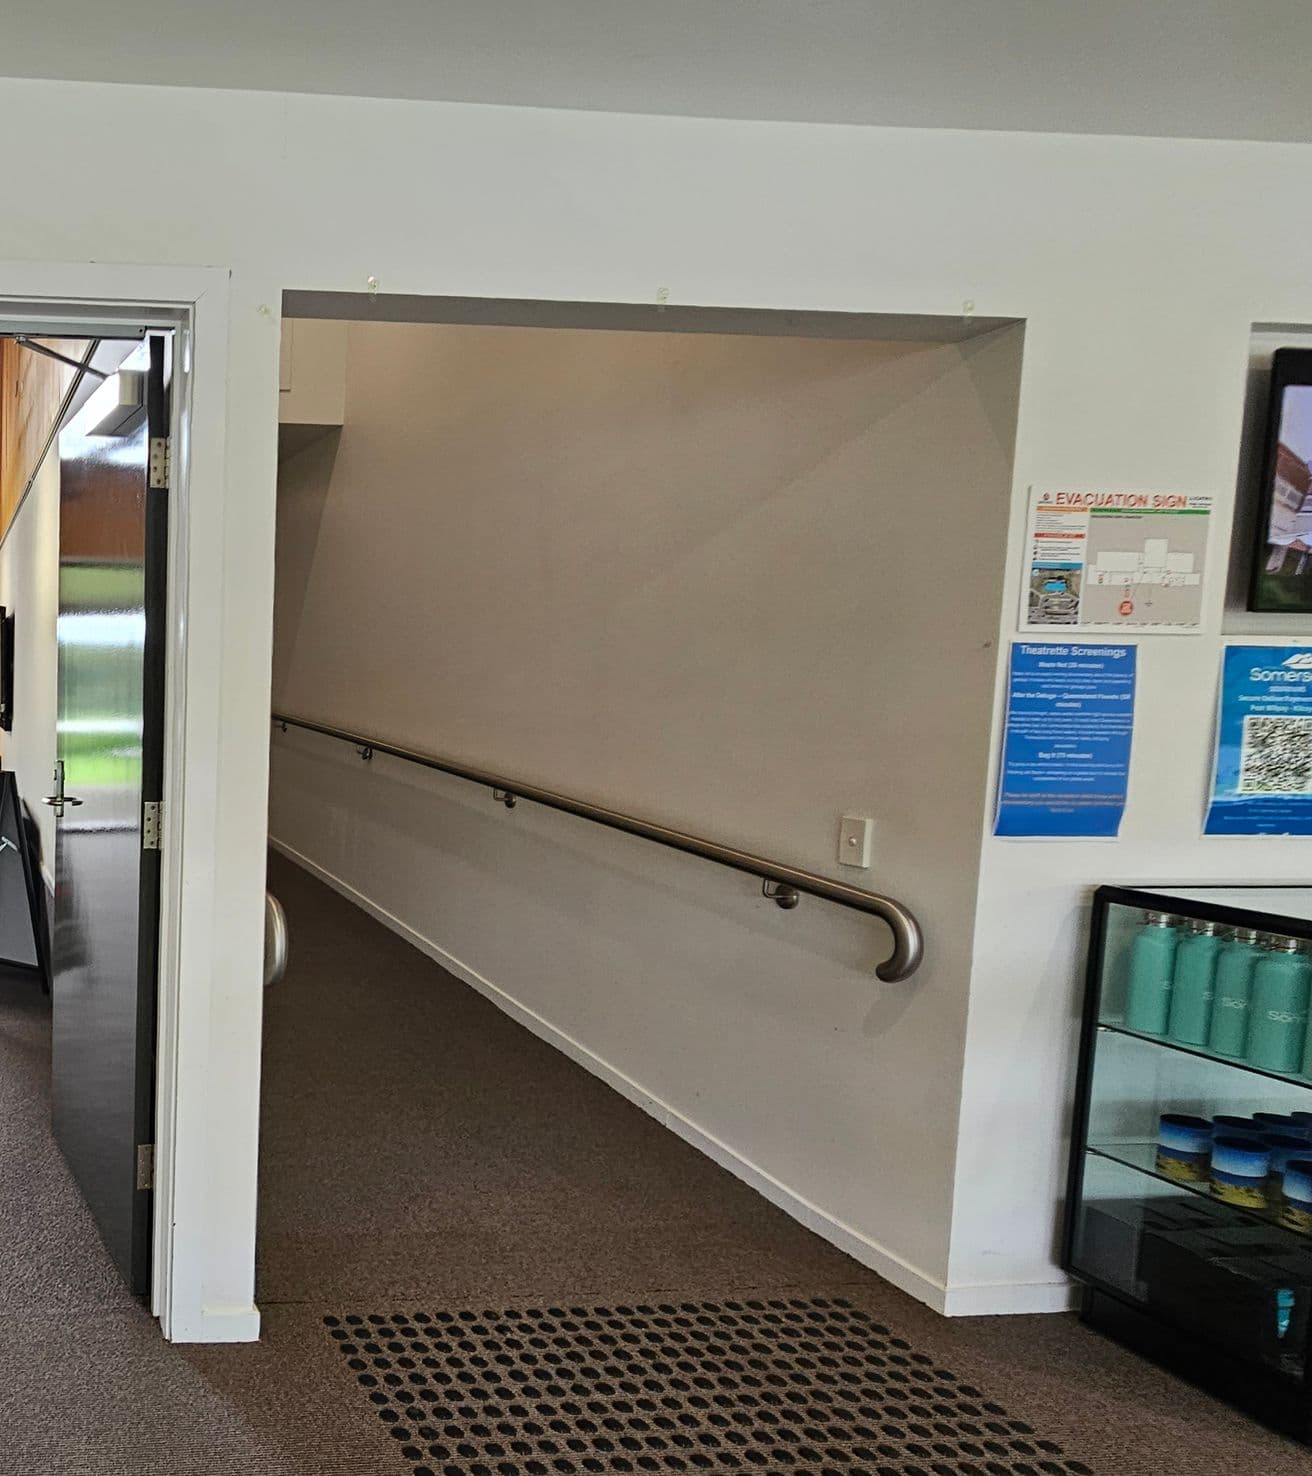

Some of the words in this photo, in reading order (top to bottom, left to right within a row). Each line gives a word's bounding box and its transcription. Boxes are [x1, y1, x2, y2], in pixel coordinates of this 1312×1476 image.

[1056, 492, 1149, 507] EVACUATION
[1153, 494, 1187, 508] SIGN
[1021, 645, 1069, 656] Theatrette
[1071, 646, 1127, 659] Screenings
